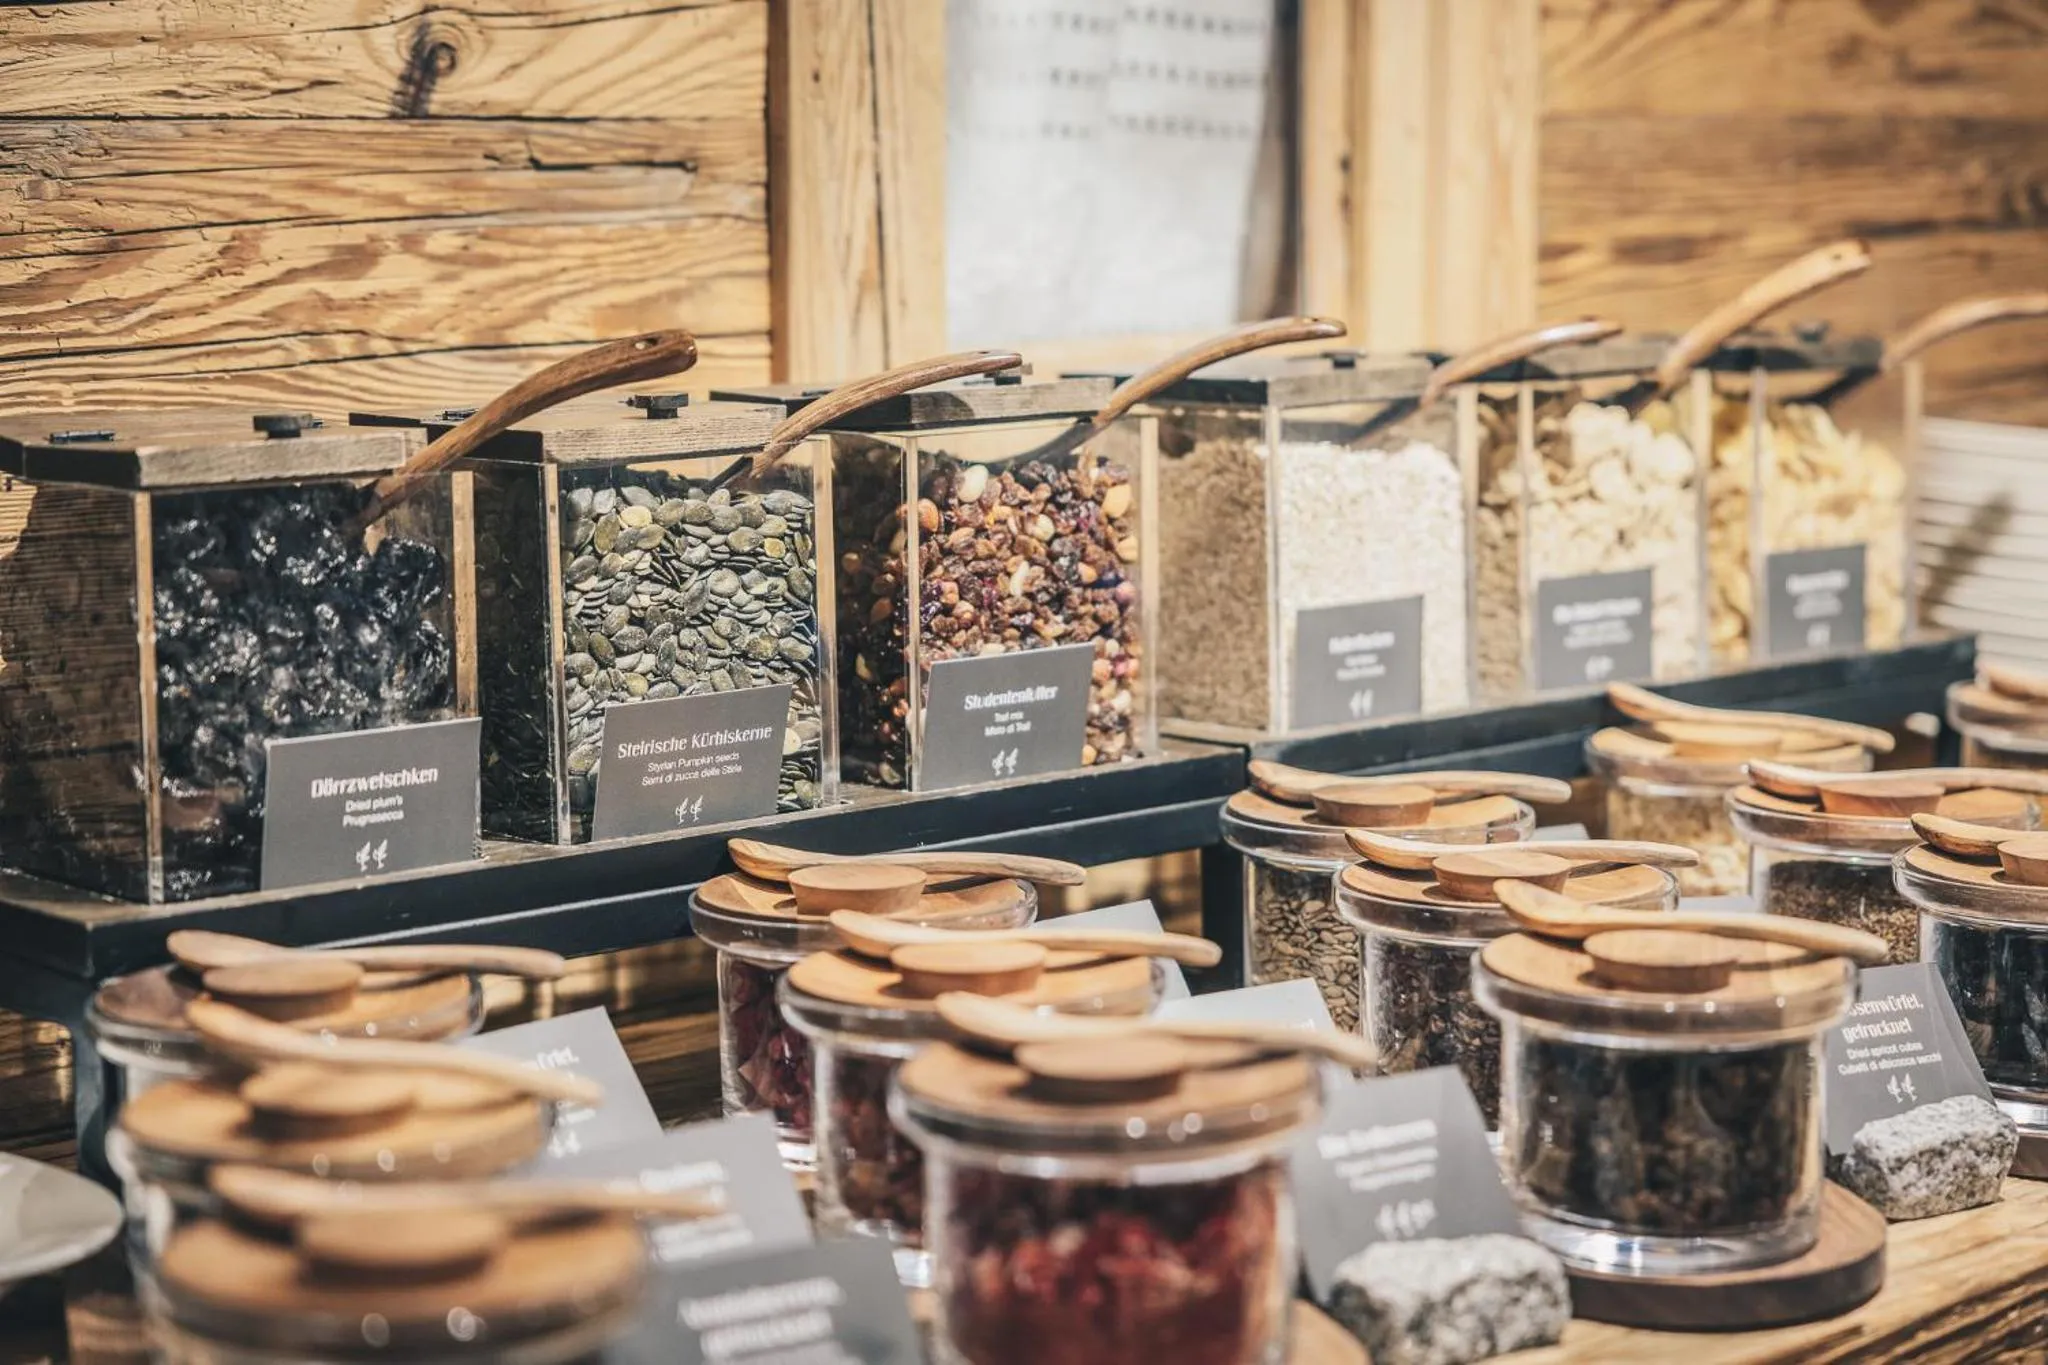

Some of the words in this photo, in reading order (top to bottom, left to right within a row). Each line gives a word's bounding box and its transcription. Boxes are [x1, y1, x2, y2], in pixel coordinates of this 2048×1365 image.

[617, 736, 687, 759] Steirische
[691, 725, 773, 749] Kürbiskerne
[648, 760, 676, 773] Styrian
[678, 756, 714, 769] Pumpkin
[311, 767, 439, 799] Dörrzwetschken
[642, 775, 663, 786] Semi
[665, 774, 673, 784] di
[1842, 1017, 1913, 1044] getrocknet
